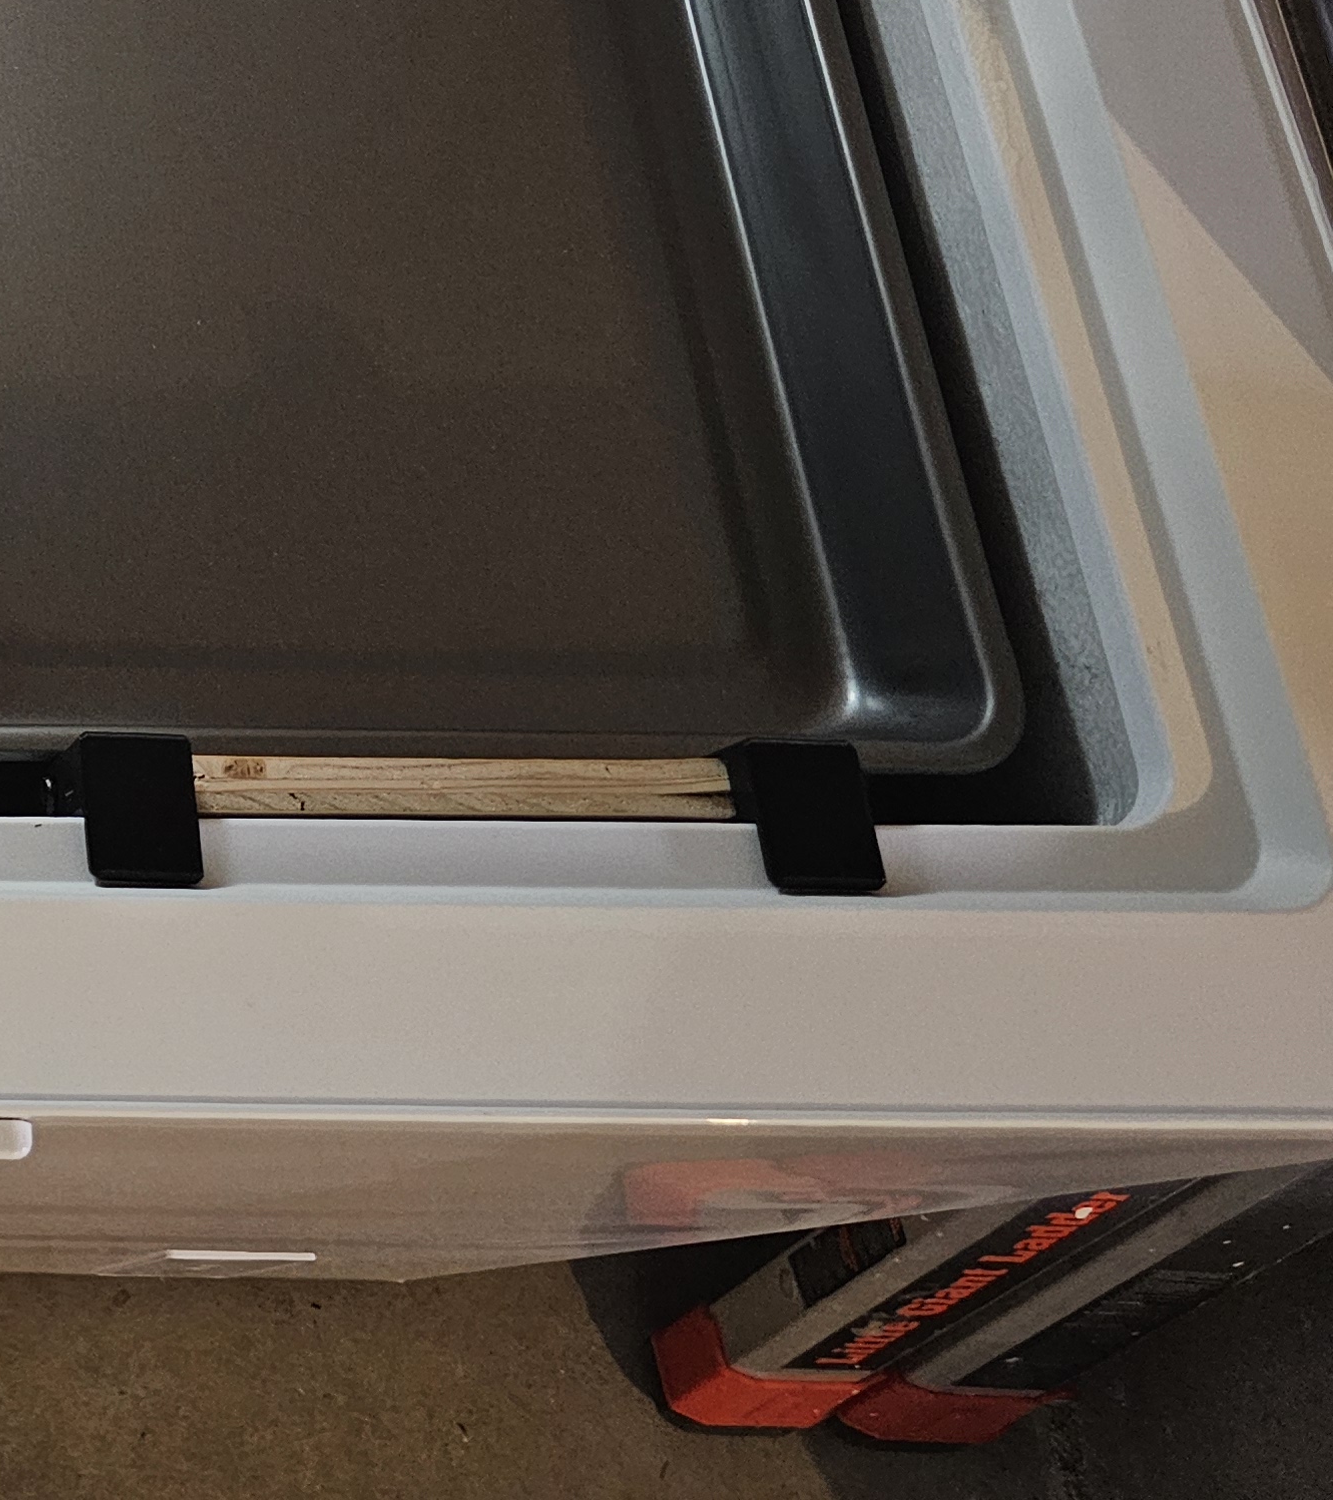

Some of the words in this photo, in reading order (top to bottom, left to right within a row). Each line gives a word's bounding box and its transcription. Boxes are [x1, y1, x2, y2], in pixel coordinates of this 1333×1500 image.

[815, 1320, 921, 1365] Little
[897, 1269, 1009, 1317] Giant
[979, 1191, 1131, 1264] Ladder
